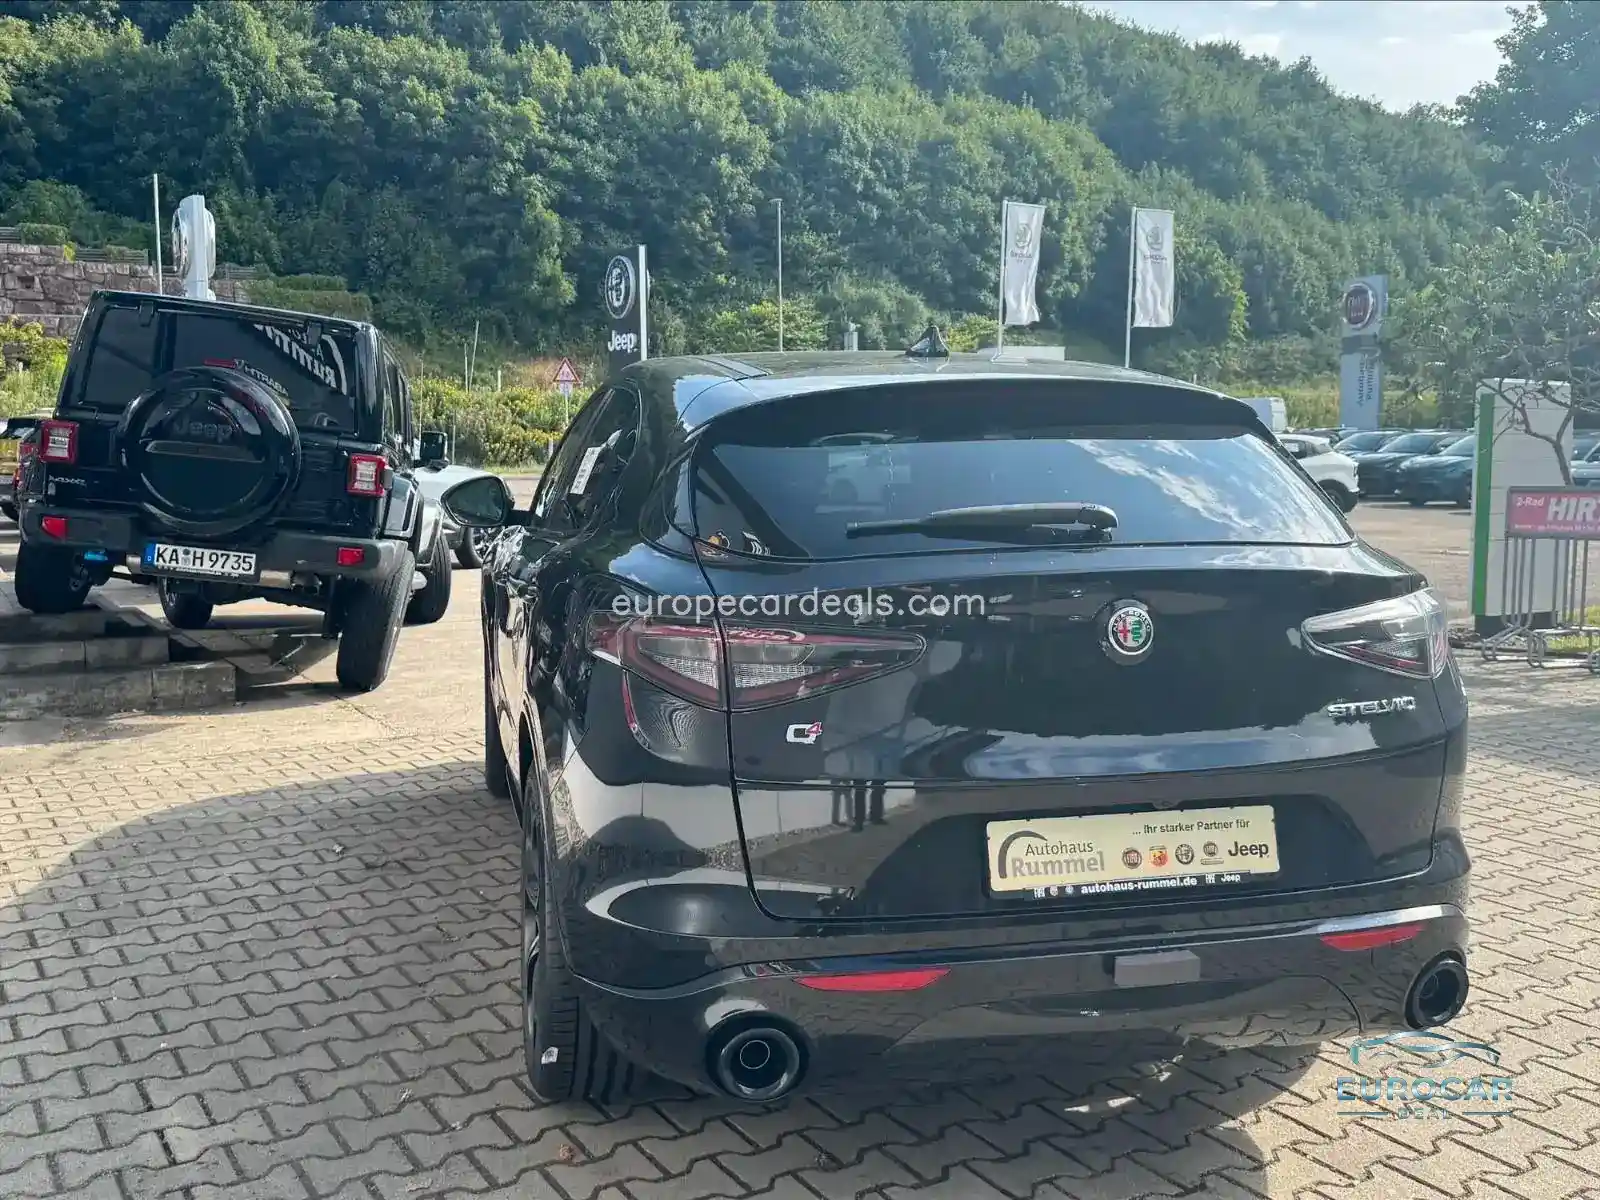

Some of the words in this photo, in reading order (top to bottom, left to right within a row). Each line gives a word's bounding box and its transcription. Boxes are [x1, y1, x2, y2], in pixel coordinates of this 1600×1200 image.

[607, 329, 637, 353] Jeep
[173, 421, 233, 443] Jeep
[1516, 496, 1545, 507] 2-Rad
[1547, 497, 1600, 522] HIR
[156, 547, 180, 565] KA
[192, 550, 206, 568] H
[208, 551, 253, 573] 9735
[1327, 695, 1416, 717] STELVIO
[1143, 823, 1158, 834] Ihr
[1160, 821, 1195, 833] starker
[1197, 819, 1234, 831] Partner
[1236, 817, 1251, 829] für
[1025, 840, 1094, 857] Autohaus
[1227, 840, 1269, 859] Jeep
[1011, 850, 1105, 878] Rummel
[1080, 876, 1198, 895] autohaus-rummel.de
[1221, 872, 1241, 883] Jeep
